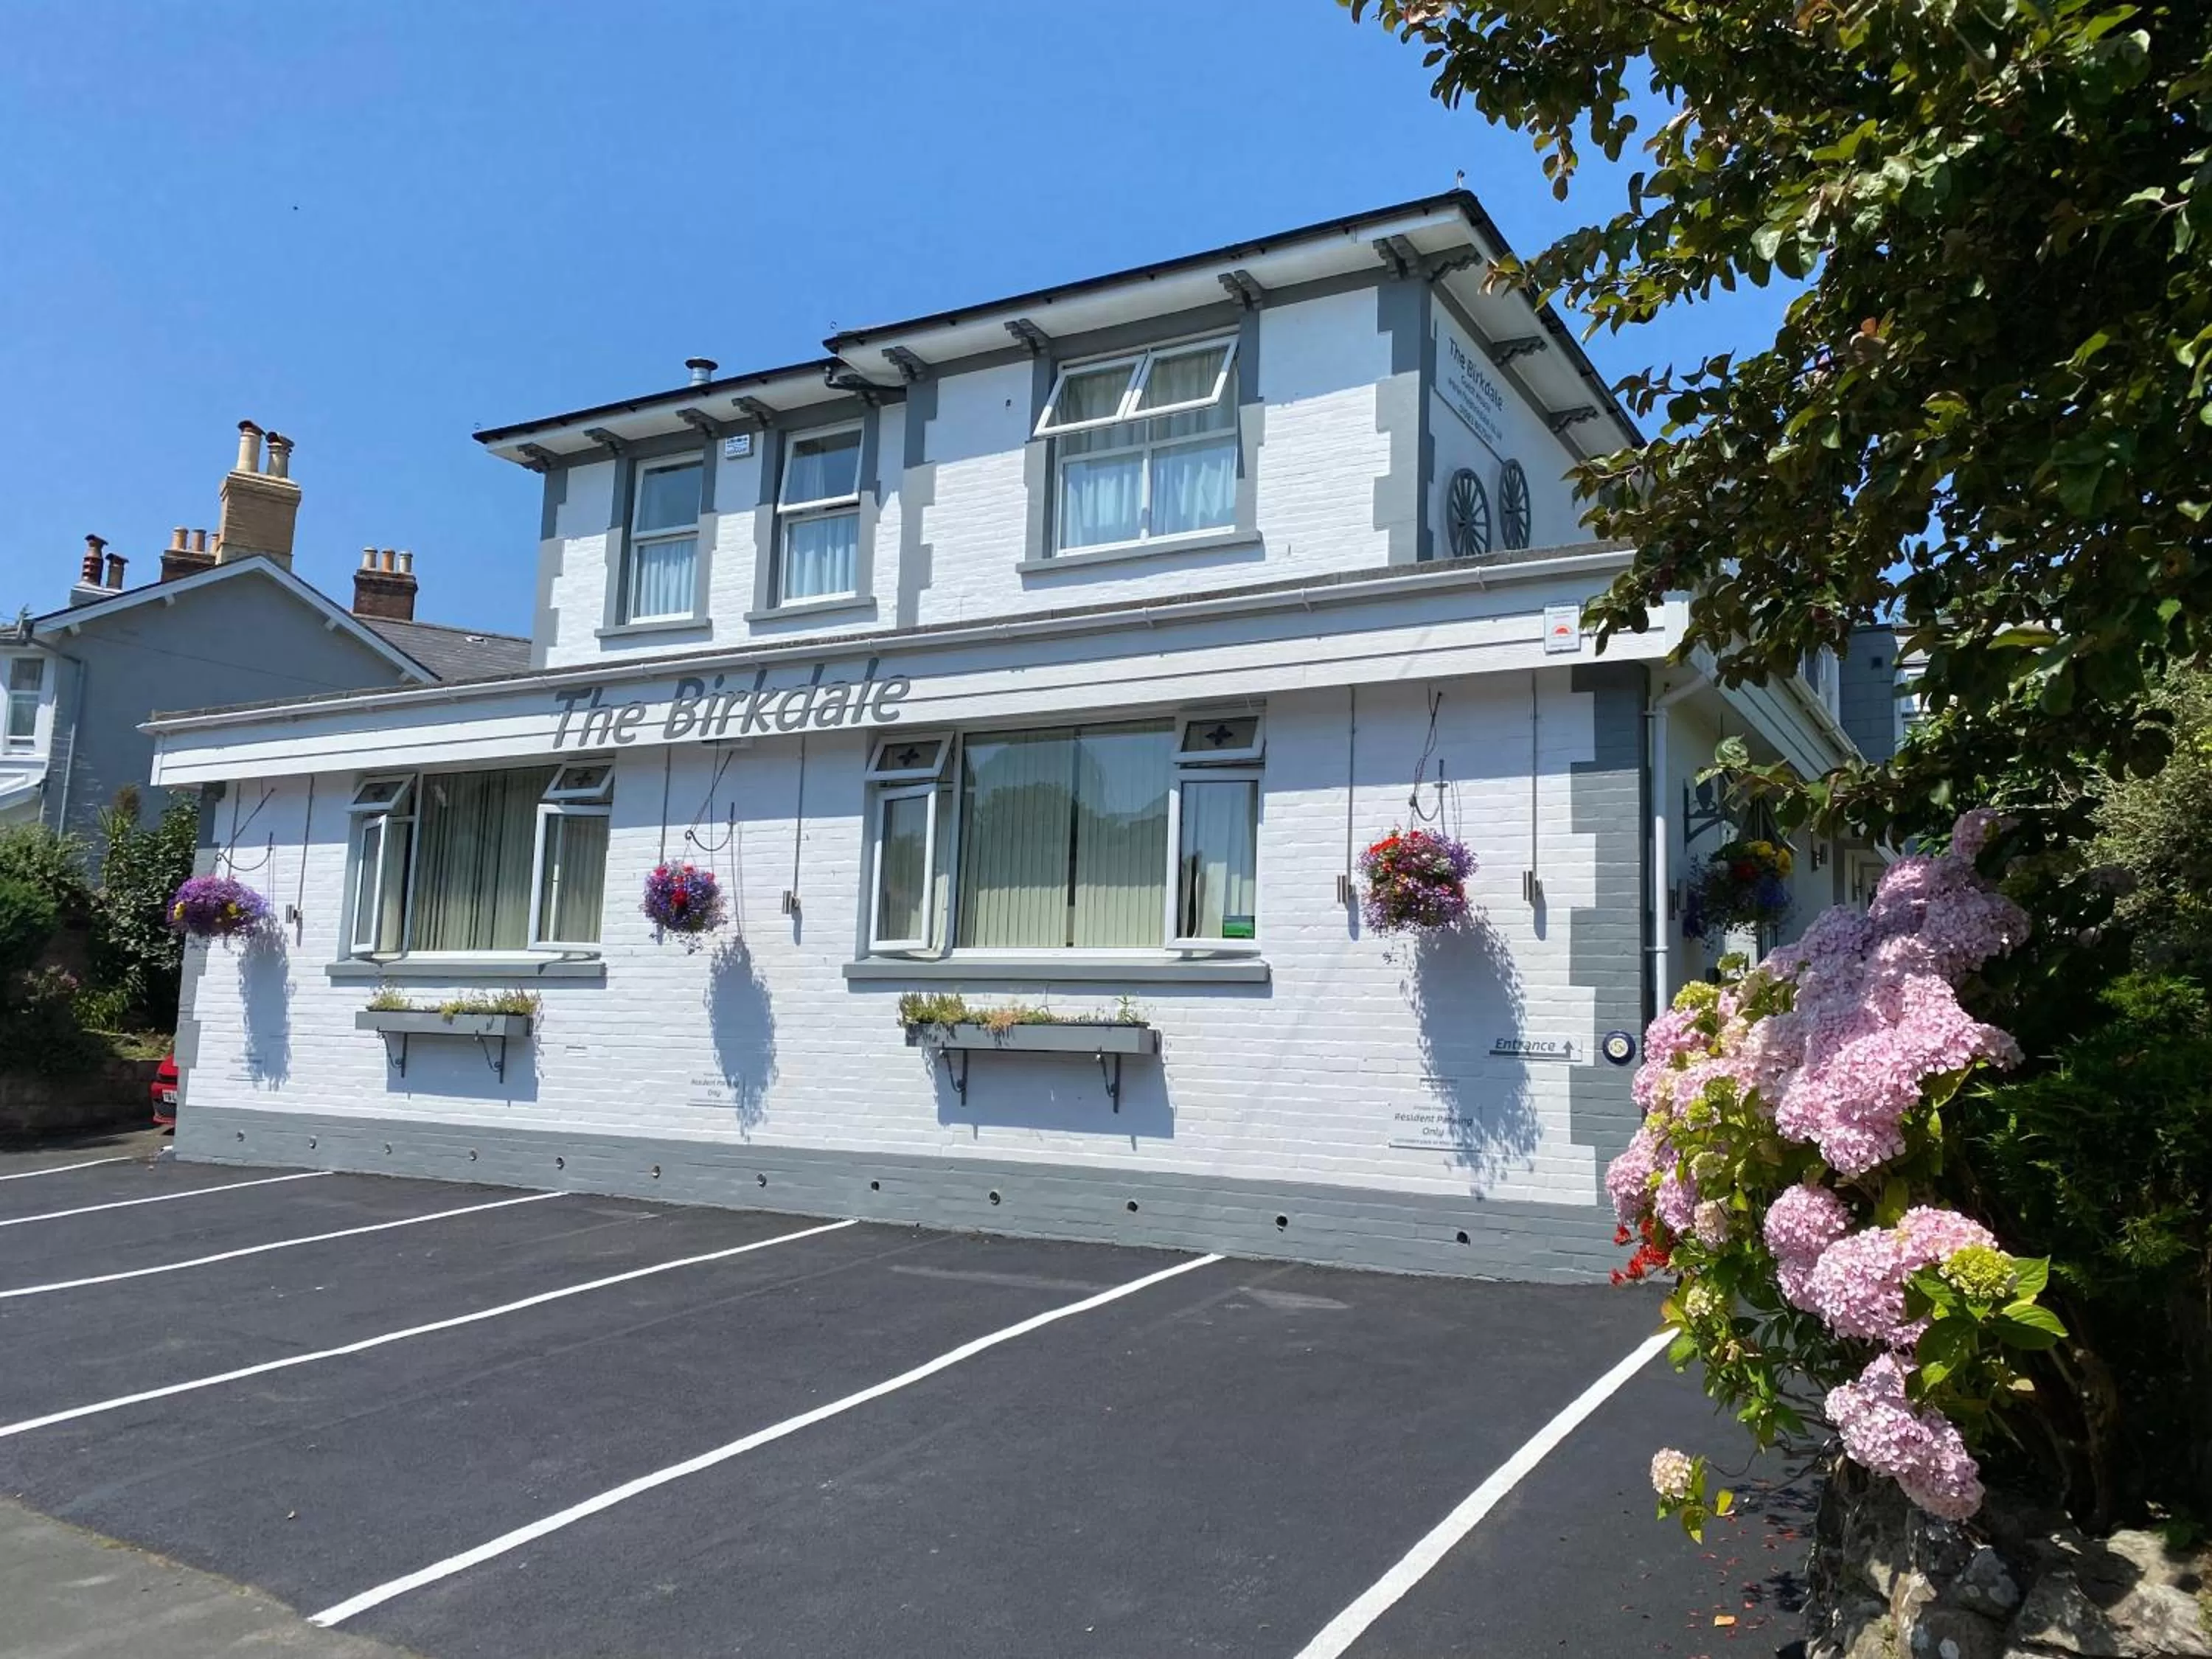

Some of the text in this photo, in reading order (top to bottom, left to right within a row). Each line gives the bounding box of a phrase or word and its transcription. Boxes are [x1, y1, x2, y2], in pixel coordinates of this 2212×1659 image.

[1448, 336, 1466, 370] The
[1467, 358, 1503, 412] Birkdale
[552, 657, 911, 749] The Birkdale
[1495, 1037, 1556, 1051] Entrance
[1394, 1113, 1435, 1123] Resident
[1422, 1127, 1445, 1137] Only
